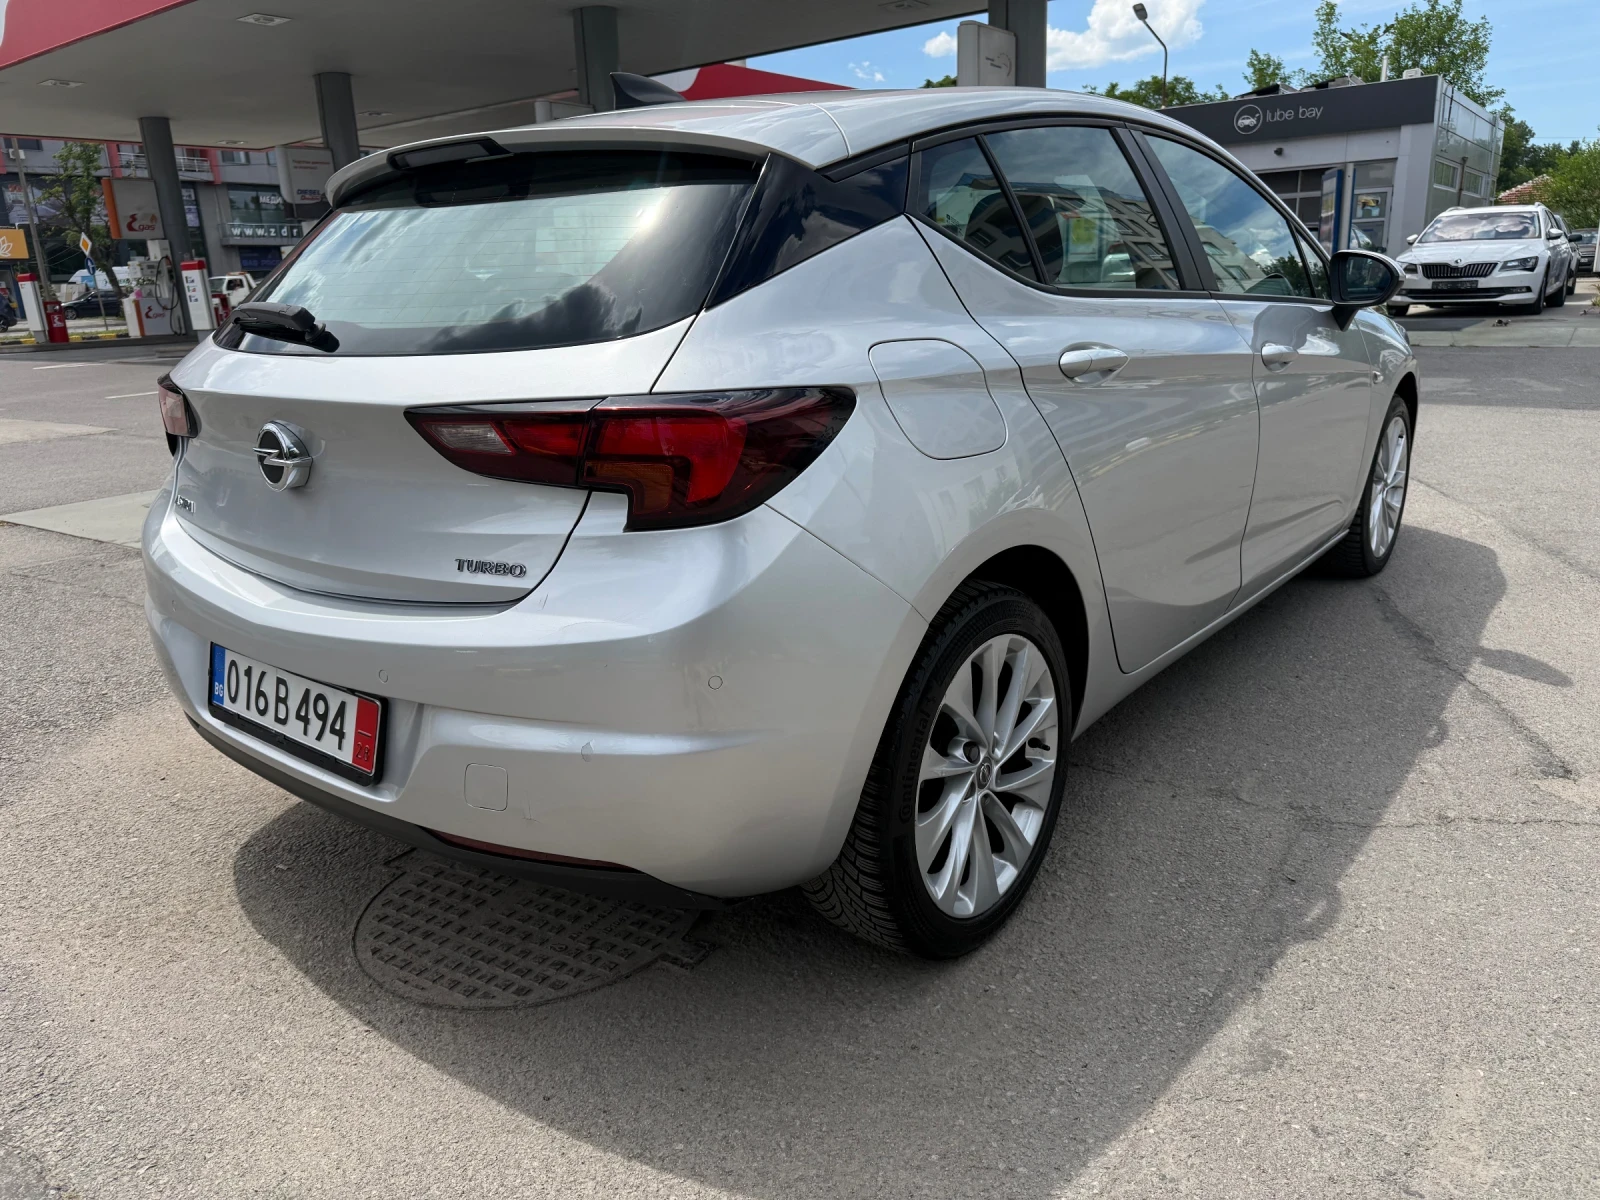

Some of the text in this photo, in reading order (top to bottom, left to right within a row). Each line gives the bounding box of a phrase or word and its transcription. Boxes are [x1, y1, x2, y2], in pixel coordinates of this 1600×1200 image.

[1266, 105, 1324, 123] lube bay
[455, 557, 528, 579] TURBO
[214, 681, 224, 697] BG
[226, 659, 347, 751] 016B494
[355, 741, 370, 762] 28
